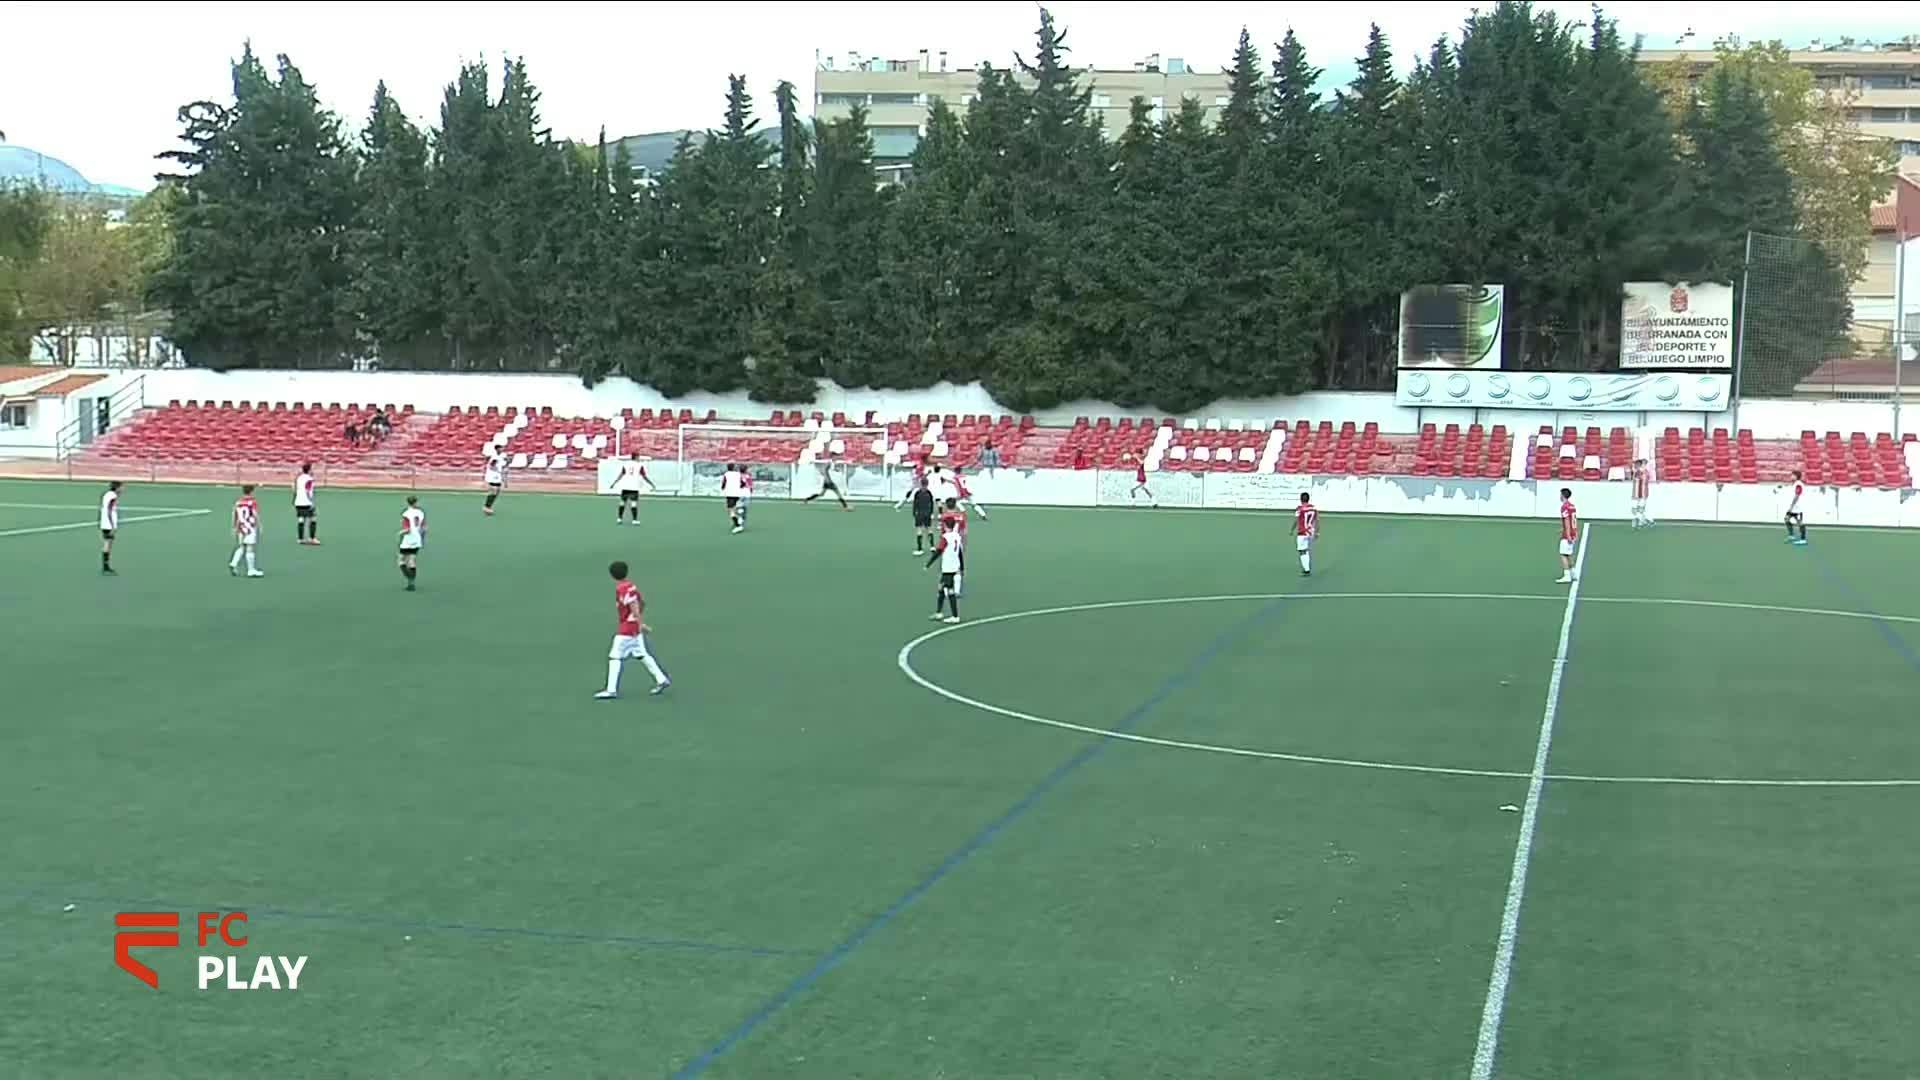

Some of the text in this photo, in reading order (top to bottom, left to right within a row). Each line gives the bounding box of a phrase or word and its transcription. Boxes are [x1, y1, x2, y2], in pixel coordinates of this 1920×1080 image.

[1645, 318, 1729, 327] AYUNTAMIENTO
[1647, 330, 1702, 339] GRANADA
[1703, 330, 1728, 339] CON
[1655, 342, 1707, 352] DEPORTE
[1709, 342, 1717, 352] Y
[1647, 354, 1686, 363] JUEGO
[1688, 355, 1725, 363] LIMPIO
[1304, 511, 1316, 528] 17
